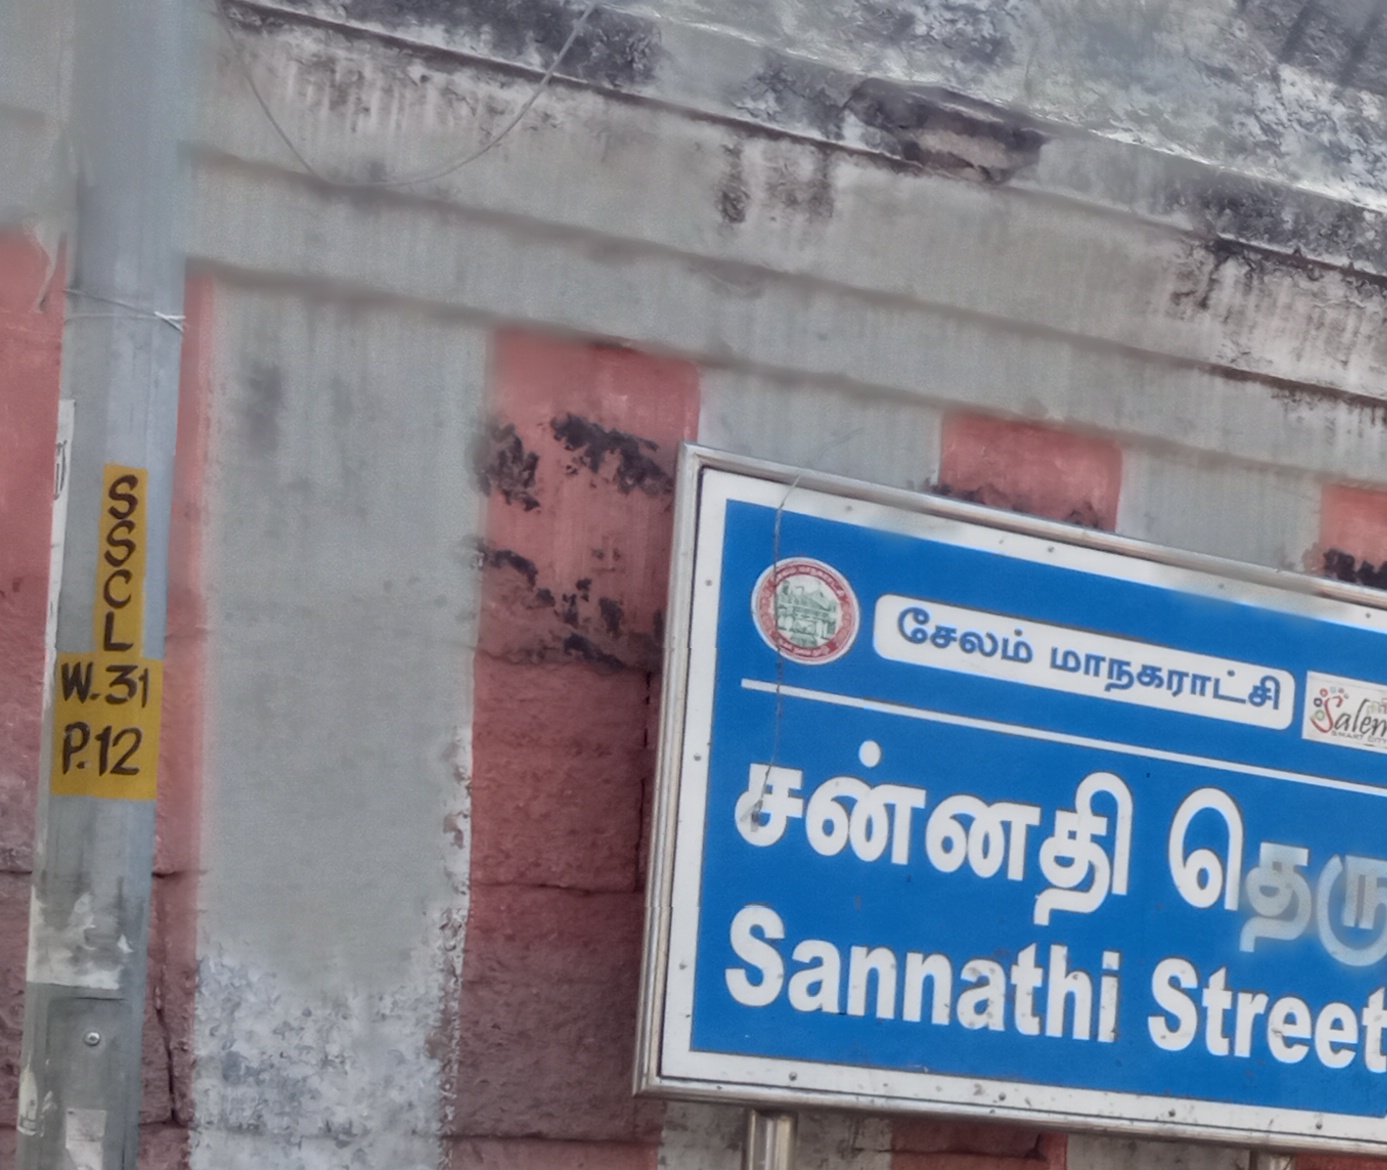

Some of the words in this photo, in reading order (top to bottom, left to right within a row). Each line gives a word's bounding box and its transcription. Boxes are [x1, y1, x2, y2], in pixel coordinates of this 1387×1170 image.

[104, 474, 139, 652] SSCL
[61, 662, 150, 709] W.31
[897, 606, 1034, 664] சேலம்
[1050, 645, 1281, 711] மாநகராட்சி
[62, 722, 143, 777] P.12
[735, 740, 1133, 926] சன்னதி
[725, 904, 1121, 1043] Sannathi
